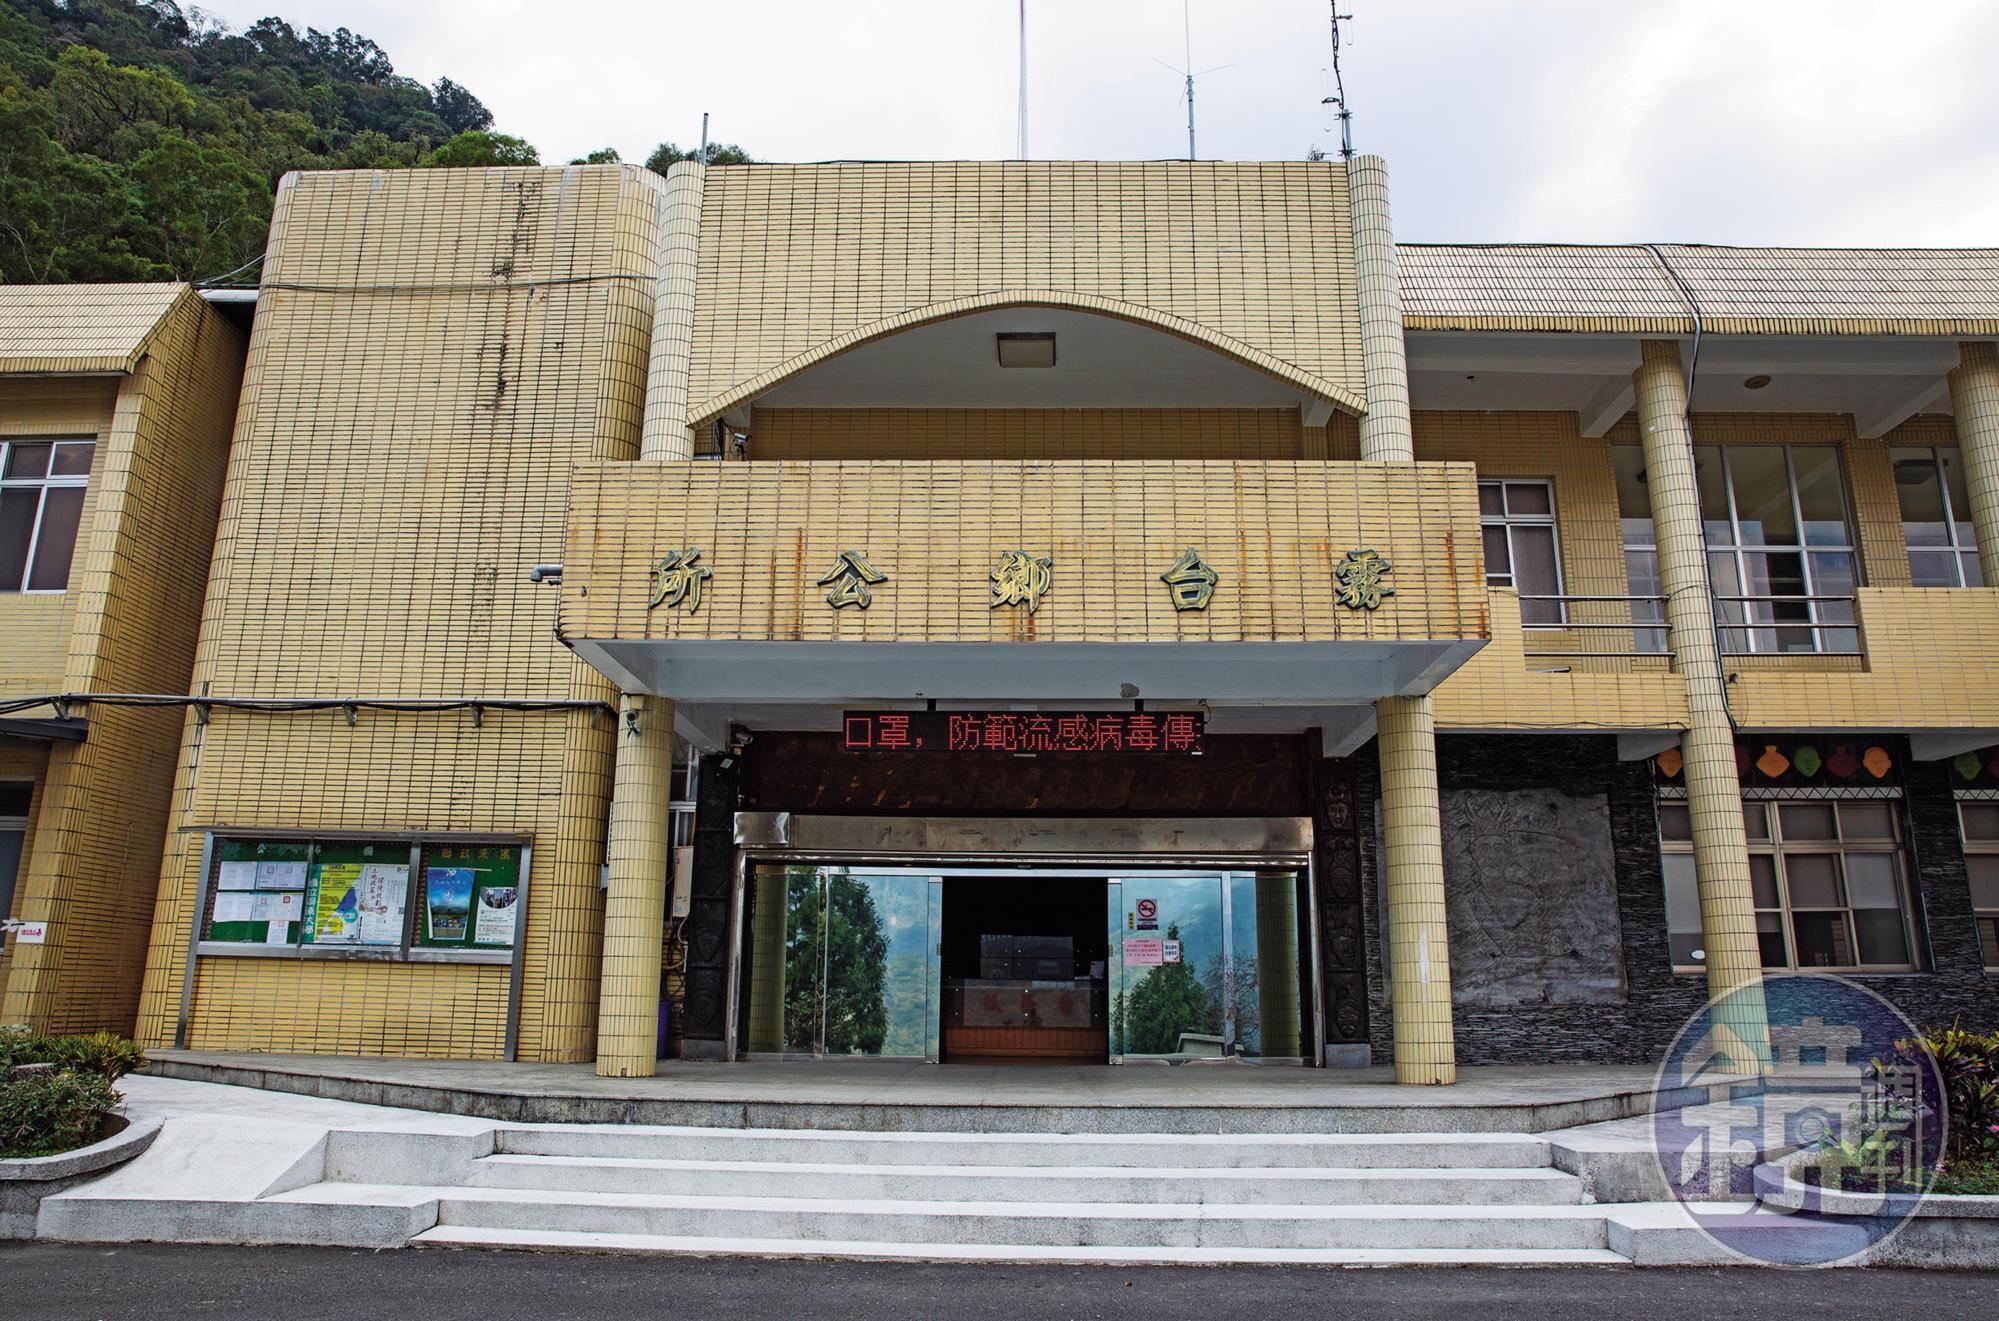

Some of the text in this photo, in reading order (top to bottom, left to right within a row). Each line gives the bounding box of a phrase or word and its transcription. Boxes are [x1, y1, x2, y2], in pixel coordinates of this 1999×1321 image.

[650, 547, 1395, 616] 霧台鄉公所
[846, 714, 1201, 751] 口罩，防範流感病毒傳
